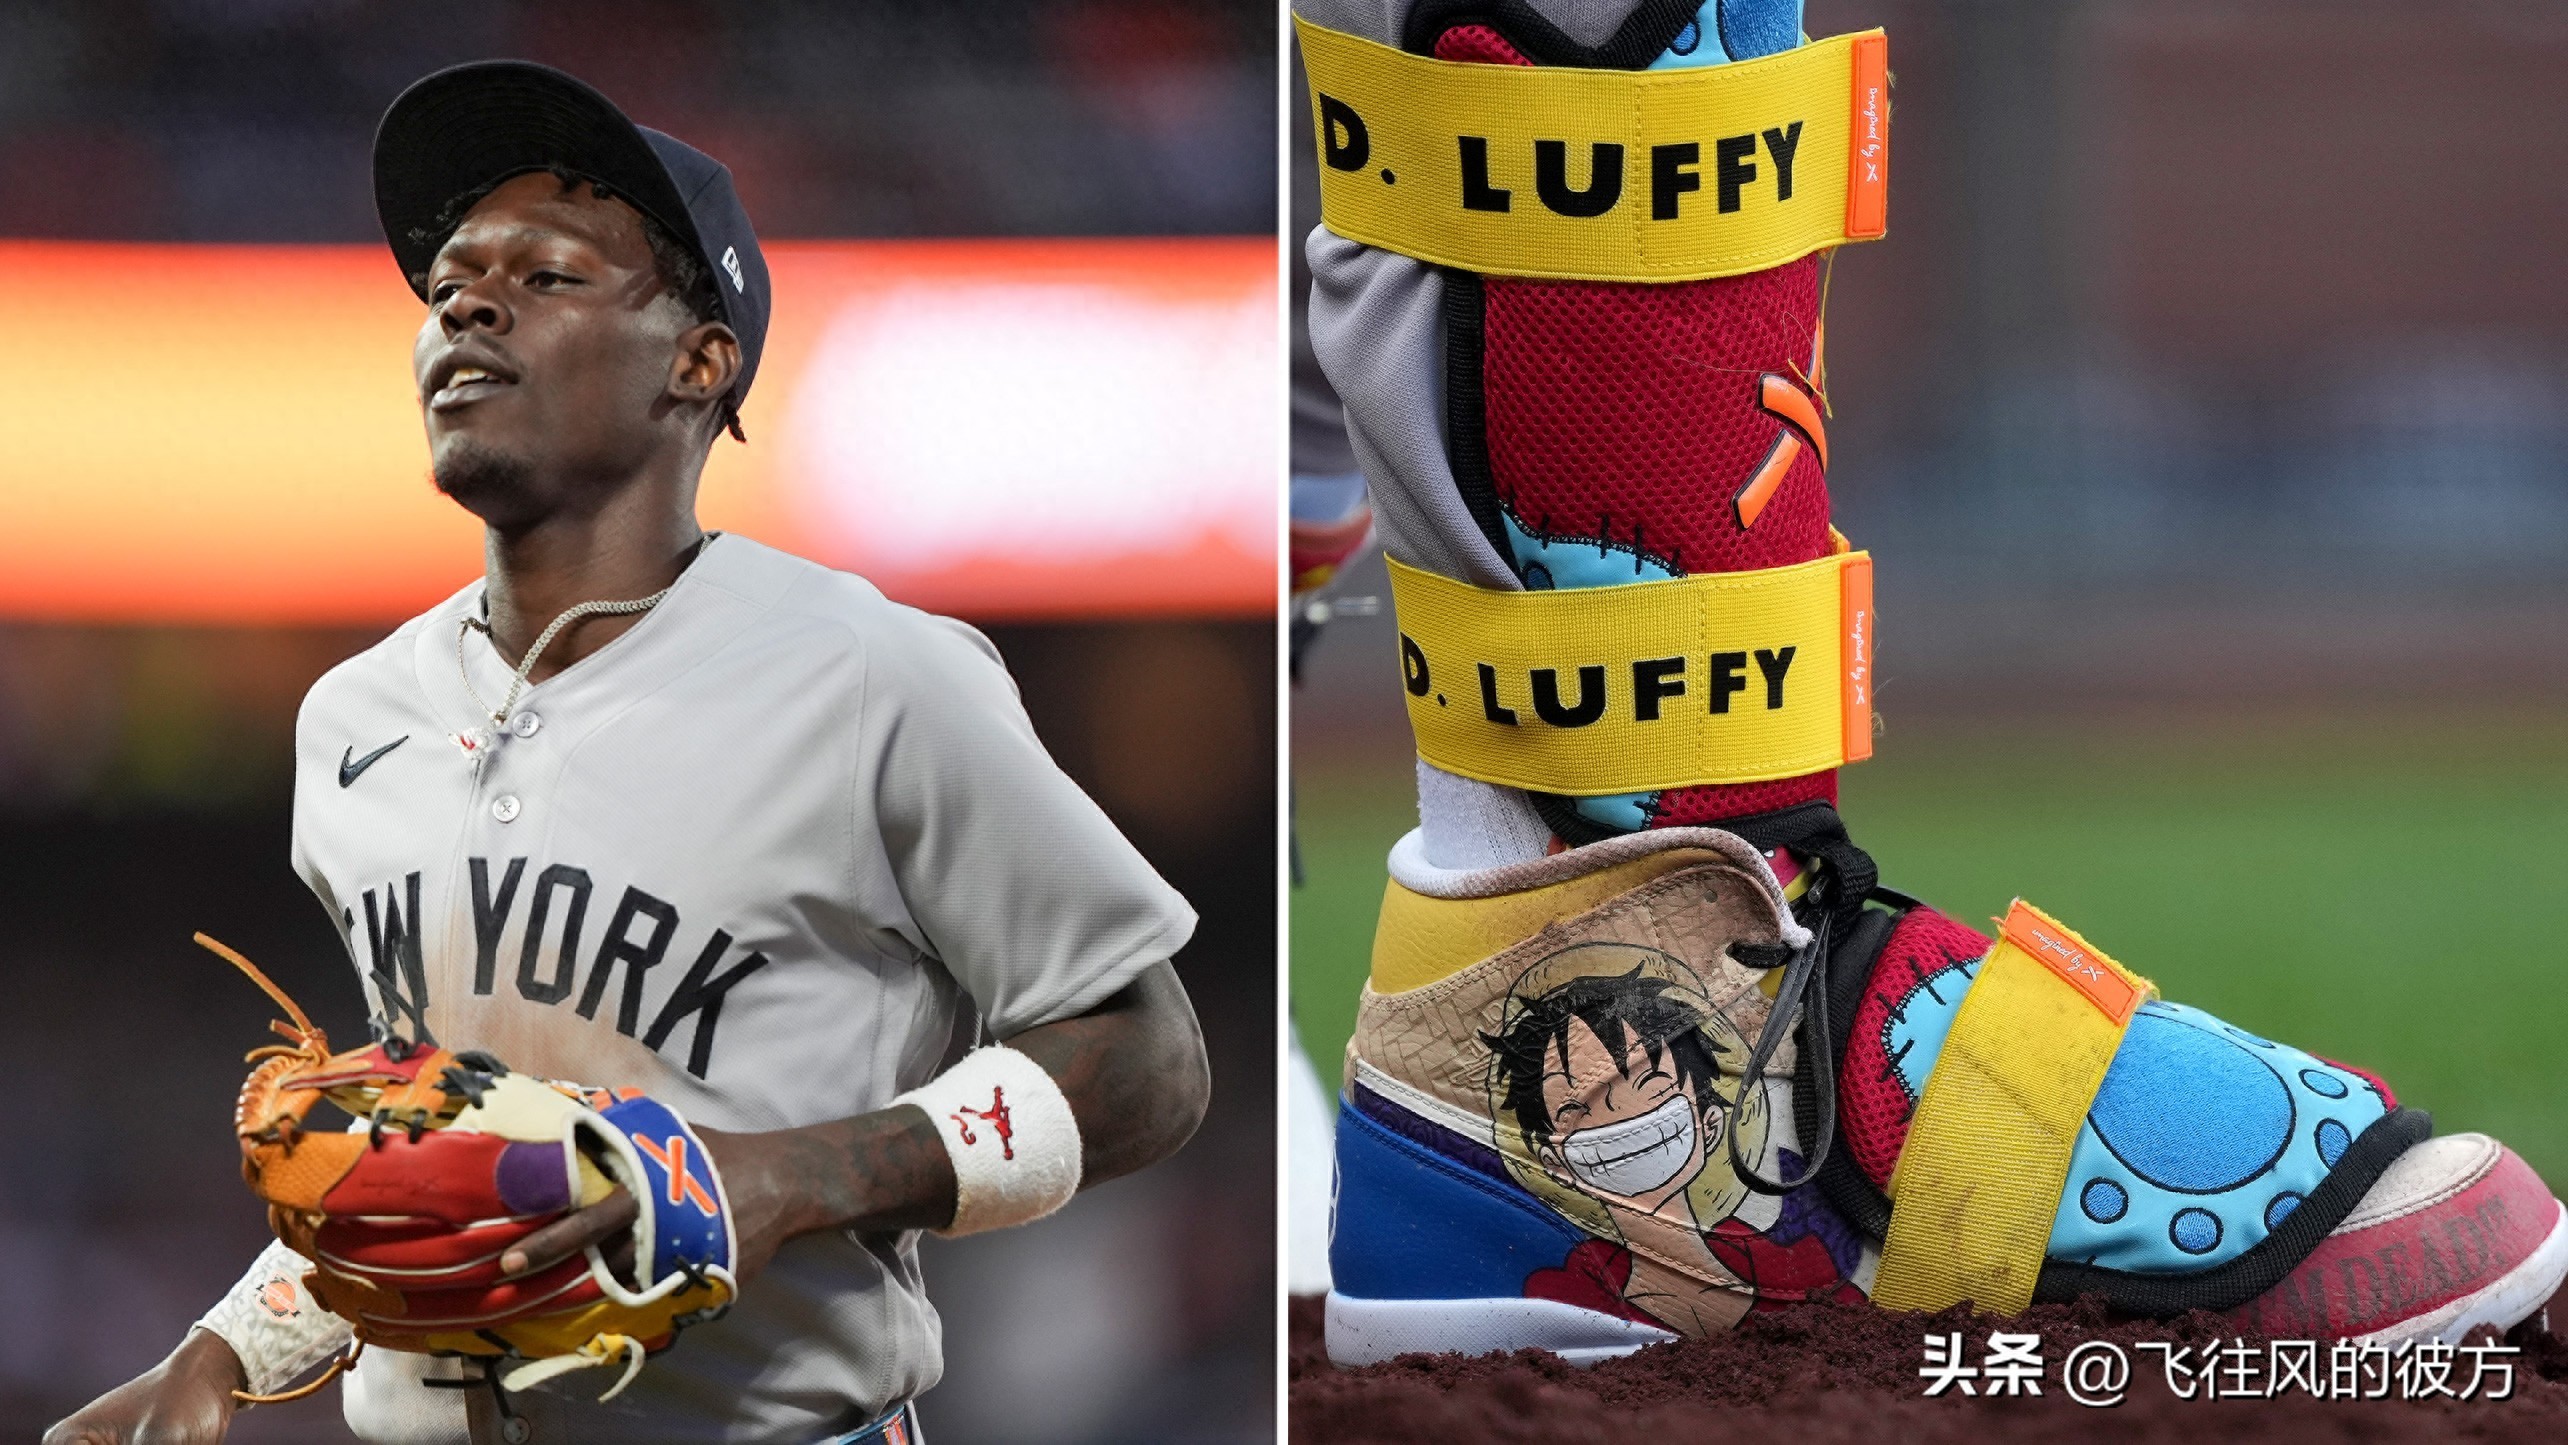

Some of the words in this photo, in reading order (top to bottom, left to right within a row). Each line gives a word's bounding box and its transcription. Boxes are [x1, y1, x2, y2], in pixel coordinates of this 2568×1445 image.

[1317, 91, 1396, 186] D.
[1457, 120, 1804, 221] LUFFY
[1399, 631, 1448, 709] D.
[1477, 645, 1797, 730] LUFFY
[468, 856, 770, 1081] YORK
